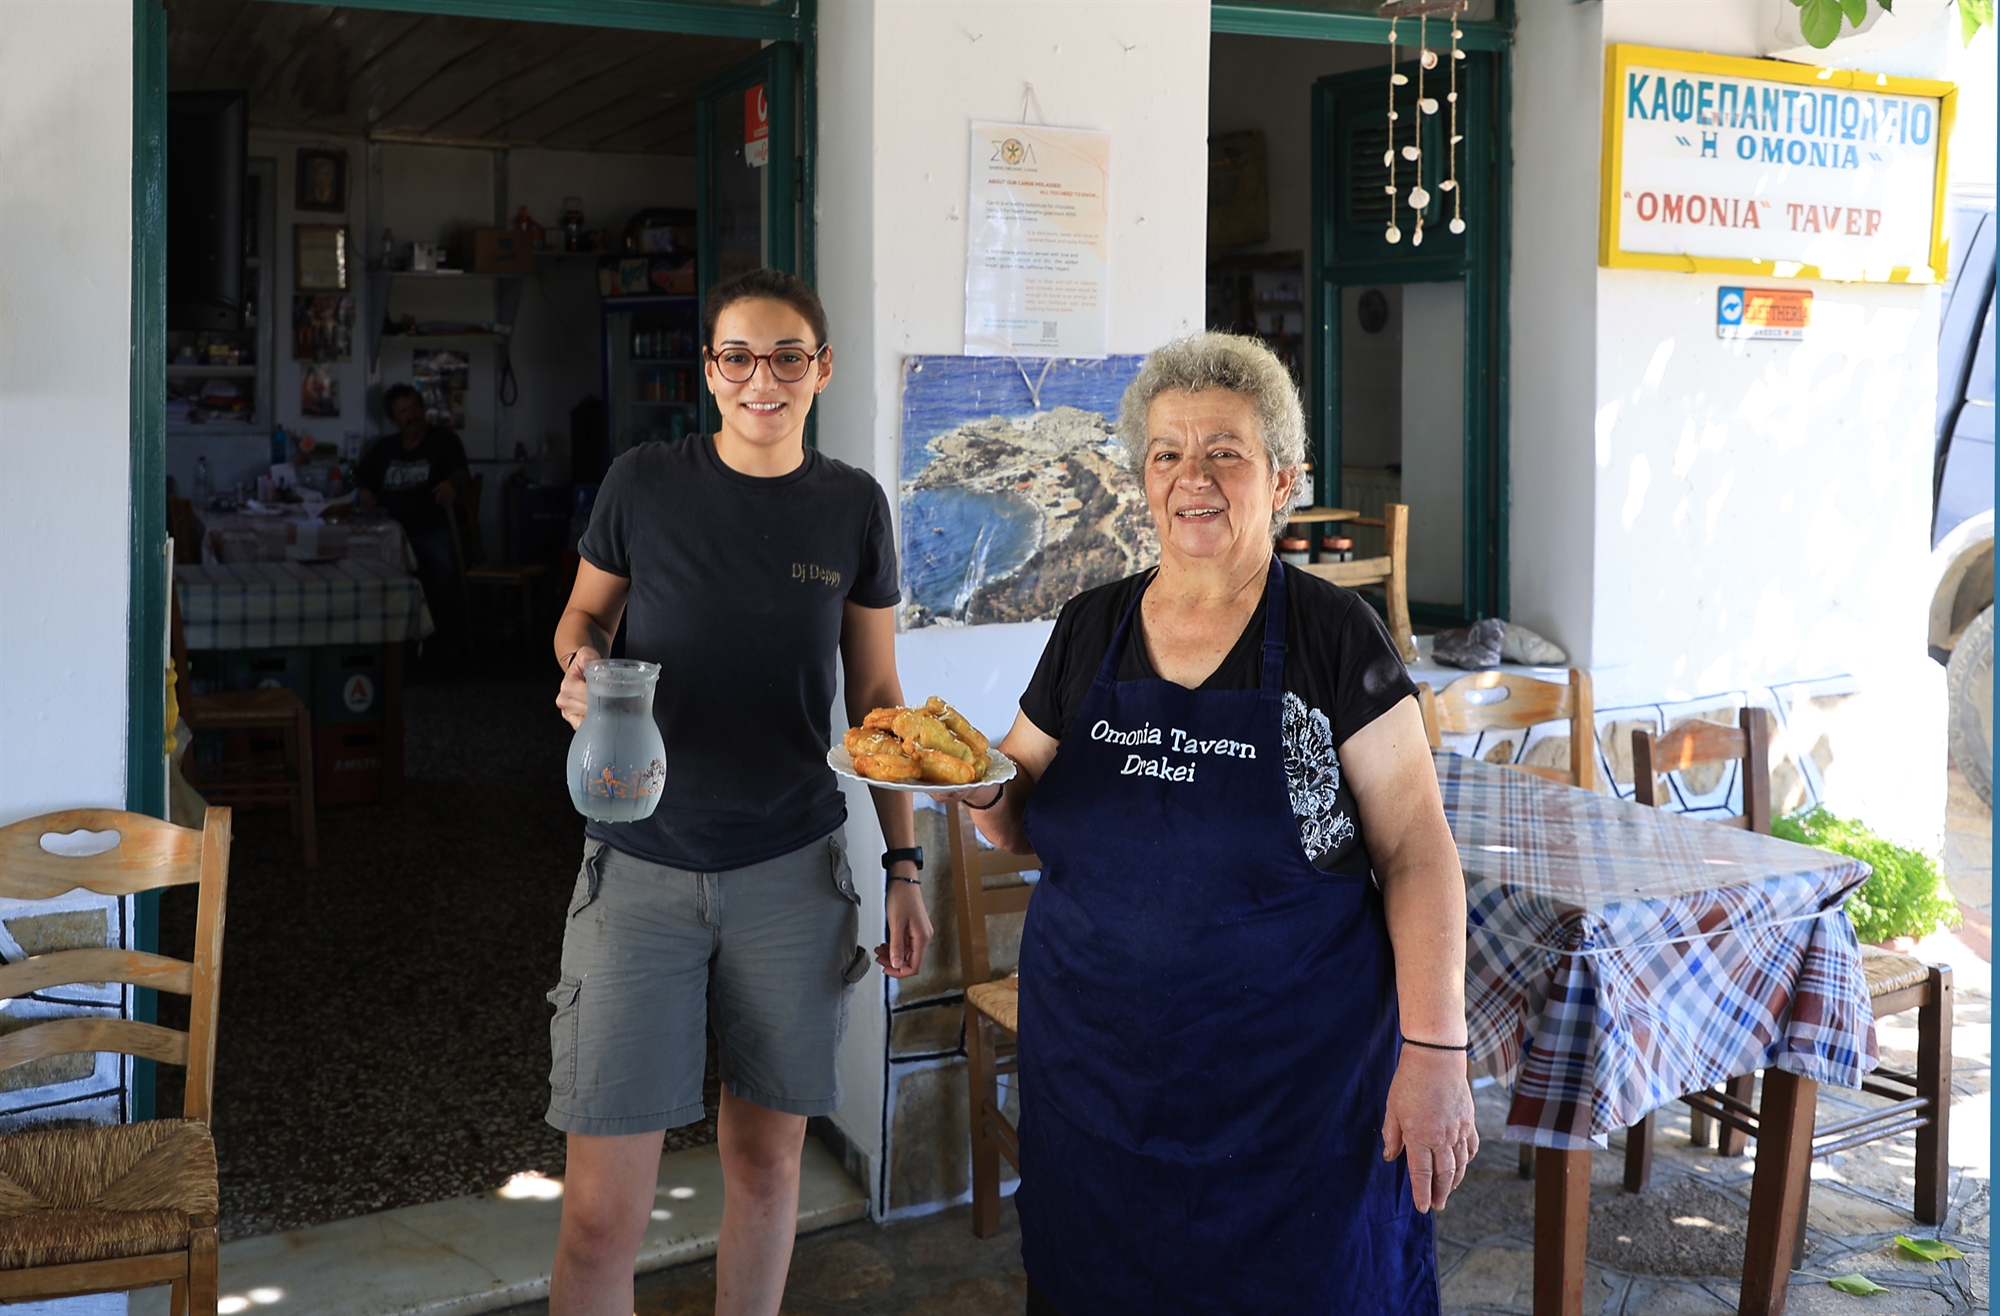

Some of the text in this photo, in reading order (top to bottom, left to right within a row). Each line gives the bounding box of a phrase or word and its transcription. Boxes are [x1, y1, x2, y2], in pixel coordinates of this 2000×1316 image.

[792, 562, 841, 588] Dj Deppy
[1090, 720, 1257, 759] Omonia Tavern
[1120, 754, 1196, 783] Drakei
